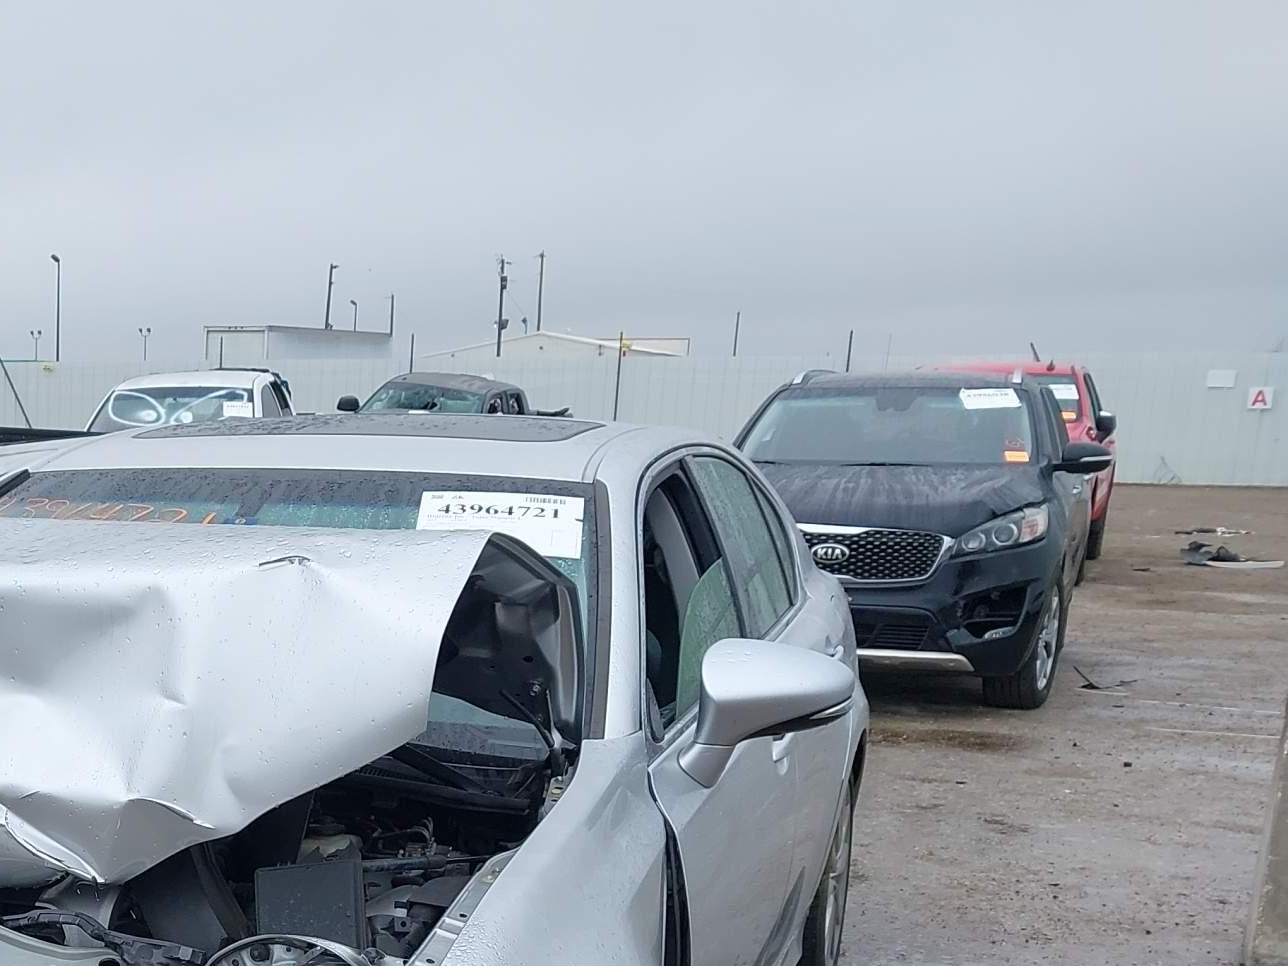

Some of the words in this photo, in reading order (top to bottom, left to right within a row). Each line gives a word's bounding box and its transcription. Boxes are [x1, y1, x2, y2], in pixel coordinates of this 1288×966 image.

[1251, 389, 1267, 406] A
[438, 503, 559, 519] 43964721
[817, 547, 843, 559] KIA
